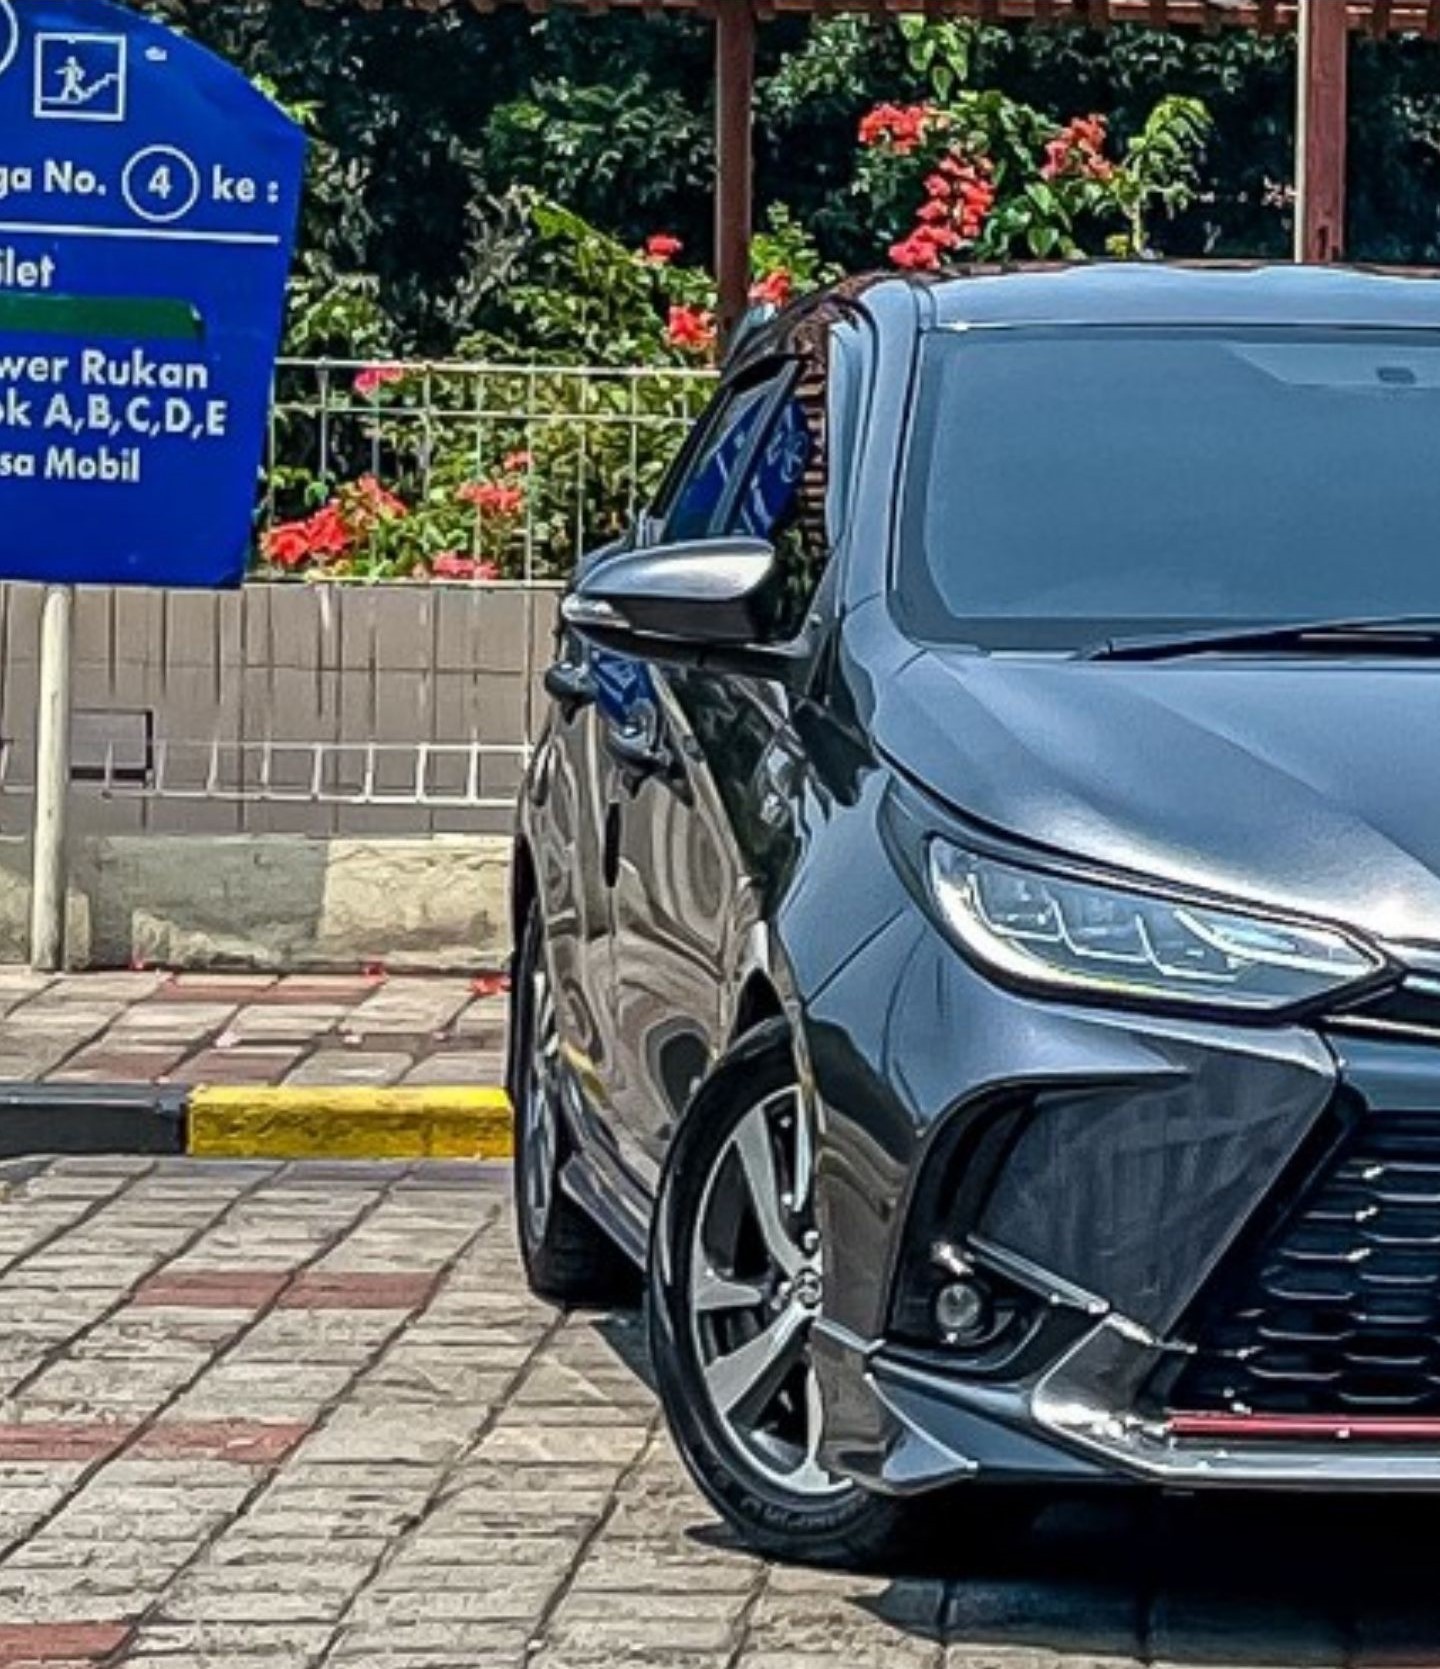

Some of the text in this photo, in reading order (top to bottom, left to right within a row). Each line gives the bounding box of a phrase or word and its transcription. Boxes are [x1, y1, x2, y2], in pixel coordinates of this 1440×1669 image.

[43, 159, 107, 196] No.
[147, 165, 172, 200] 4
[212, 163, 256, 202] ke
[81, 347, 208, 390] Rukan
[0, 386, 227, 439] k A,B,C,D,E
[43, 445, 141, 482] Mobil
